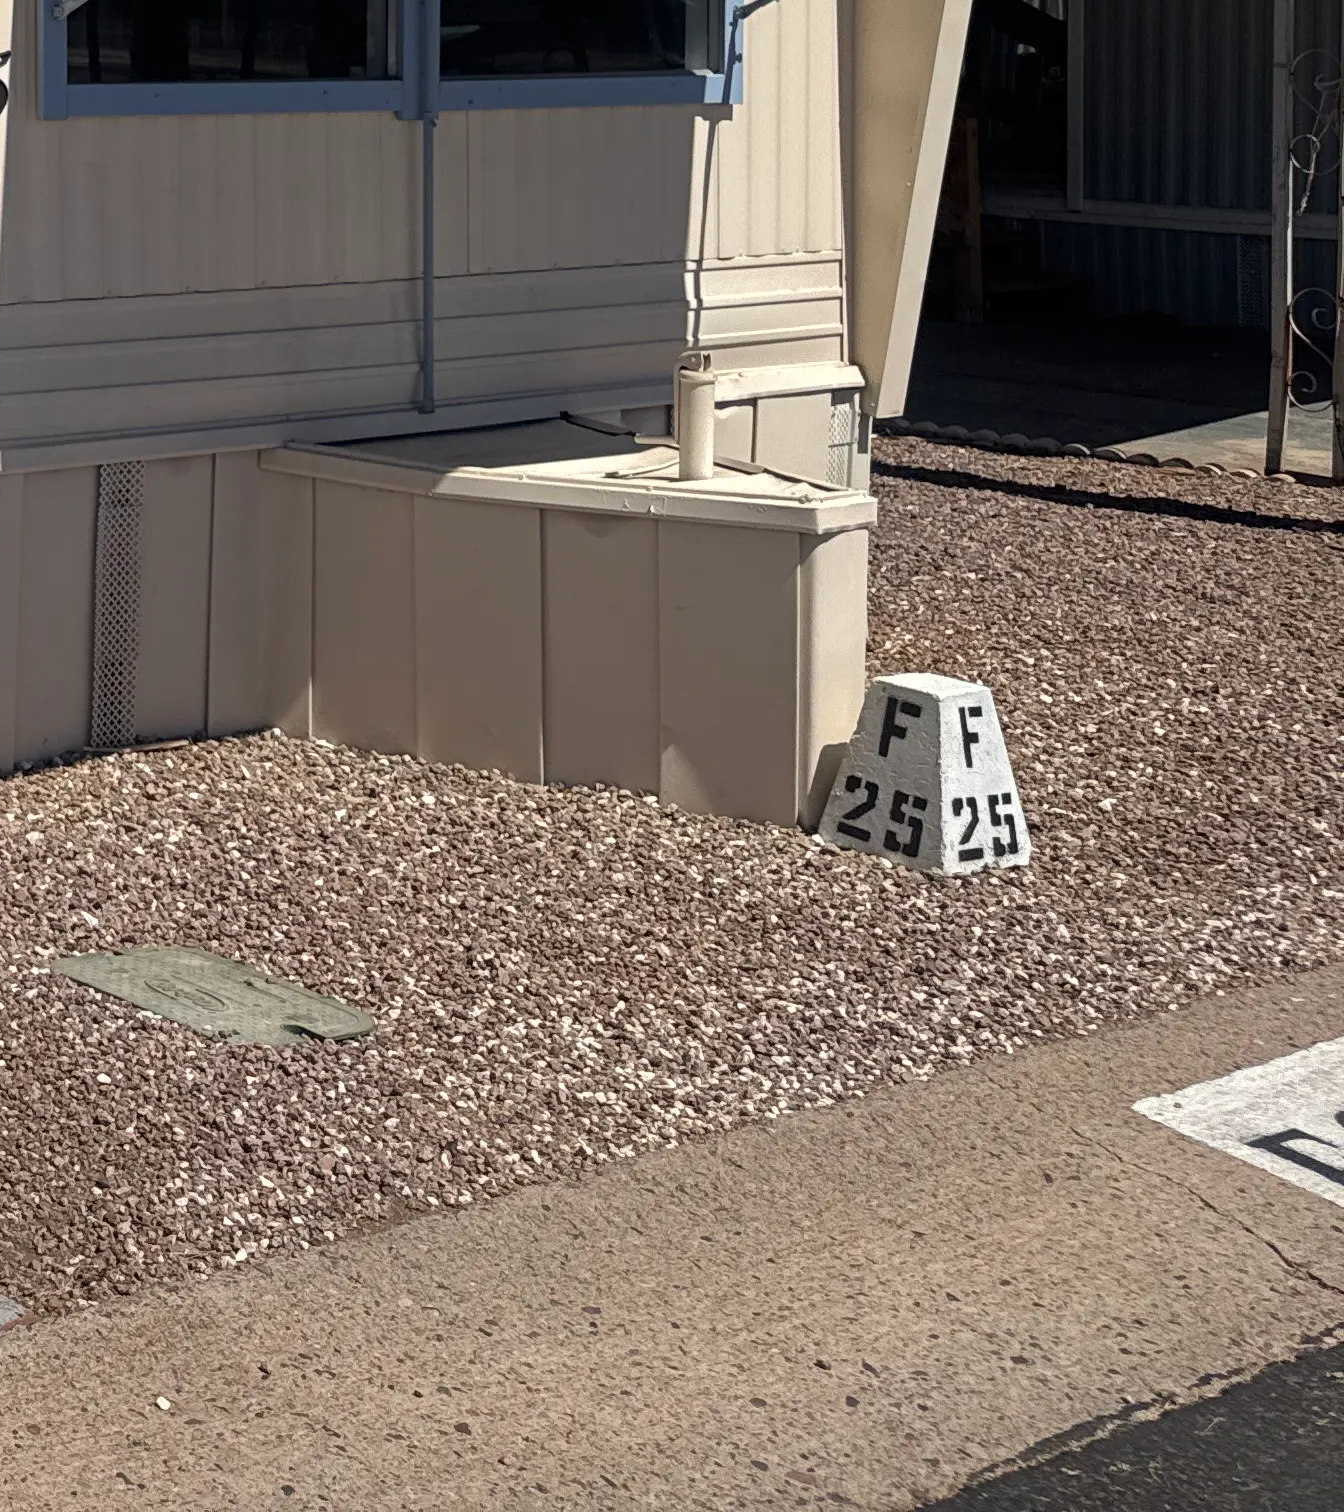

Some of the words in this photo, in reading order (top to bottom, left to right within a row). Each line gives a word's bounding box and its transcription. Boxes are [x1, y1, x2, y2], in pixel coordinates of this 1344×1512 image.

[878, 696, 922, 757] F
[958, 706, 983, 768] F
[837, 775, 928, 858] 25
[952, 792, 1019, 863] 25
